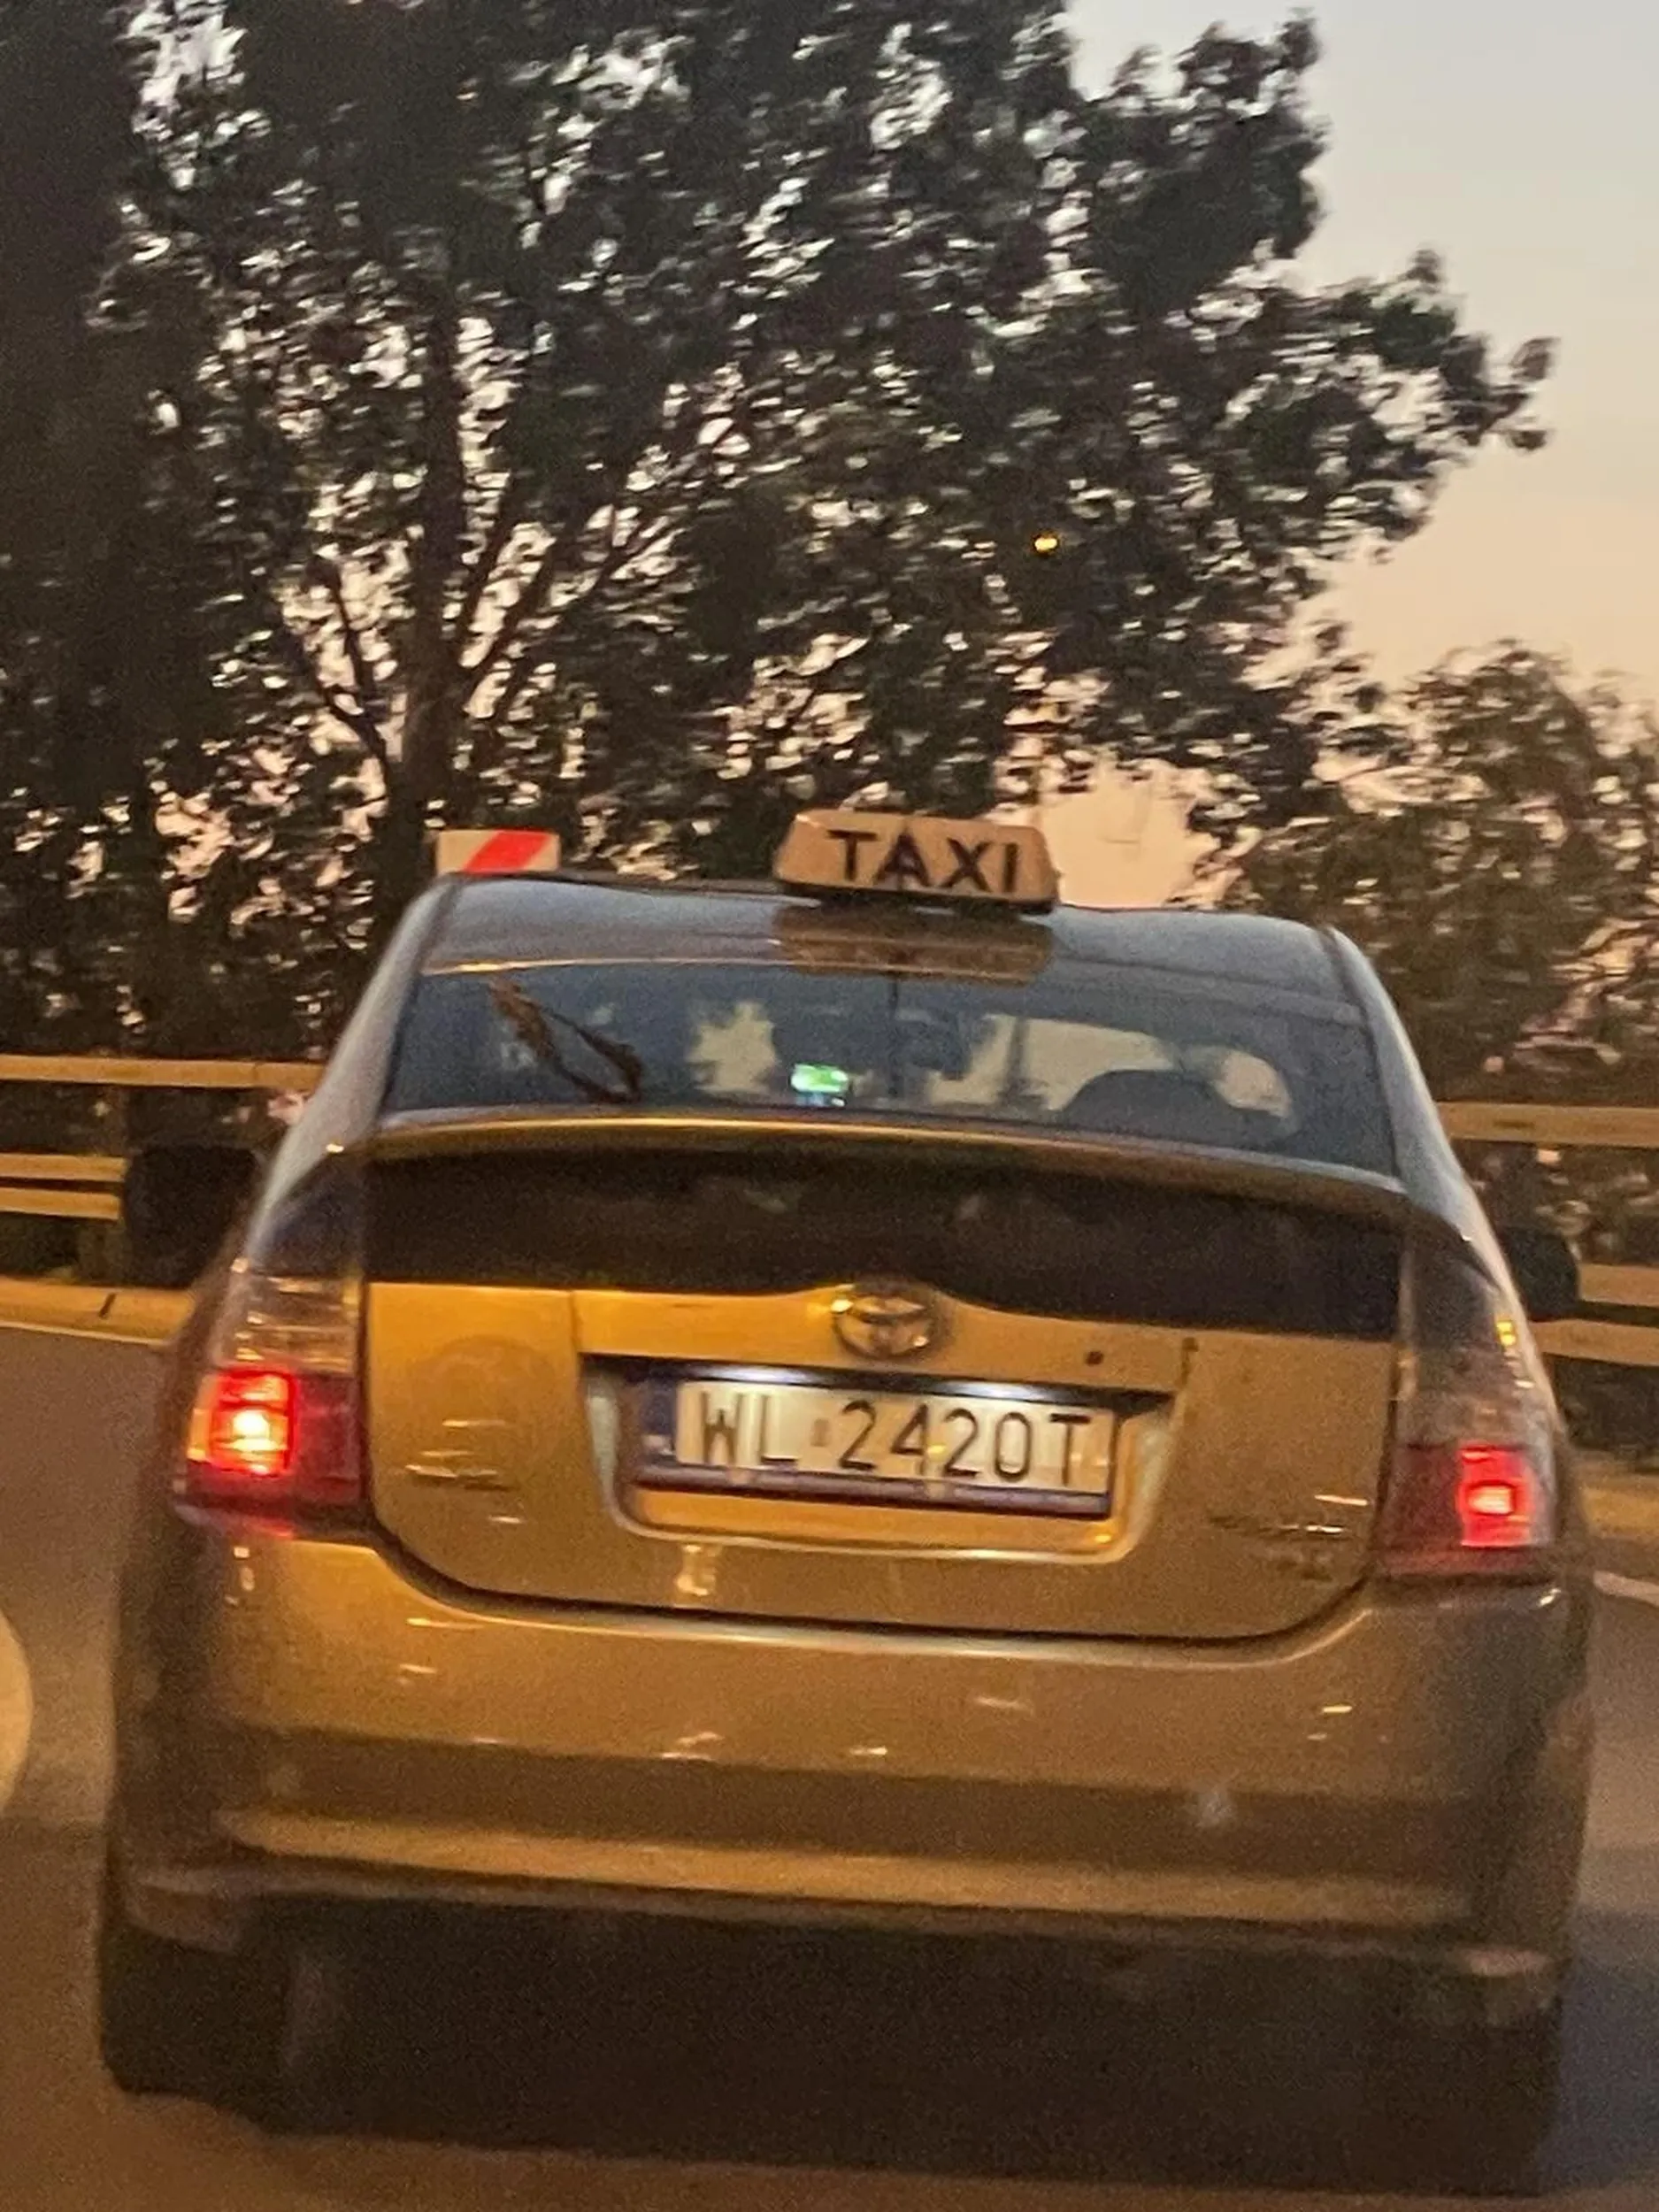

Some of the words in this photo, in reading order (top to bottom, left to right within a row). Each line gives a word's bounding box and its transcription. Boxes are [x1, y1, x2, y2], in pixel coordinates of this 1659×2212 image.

[827, 828, 1018, 893] TAXI
[700, 1391, 798, 1465] WL
[839, 1400, 1090, 1486] 2420T
